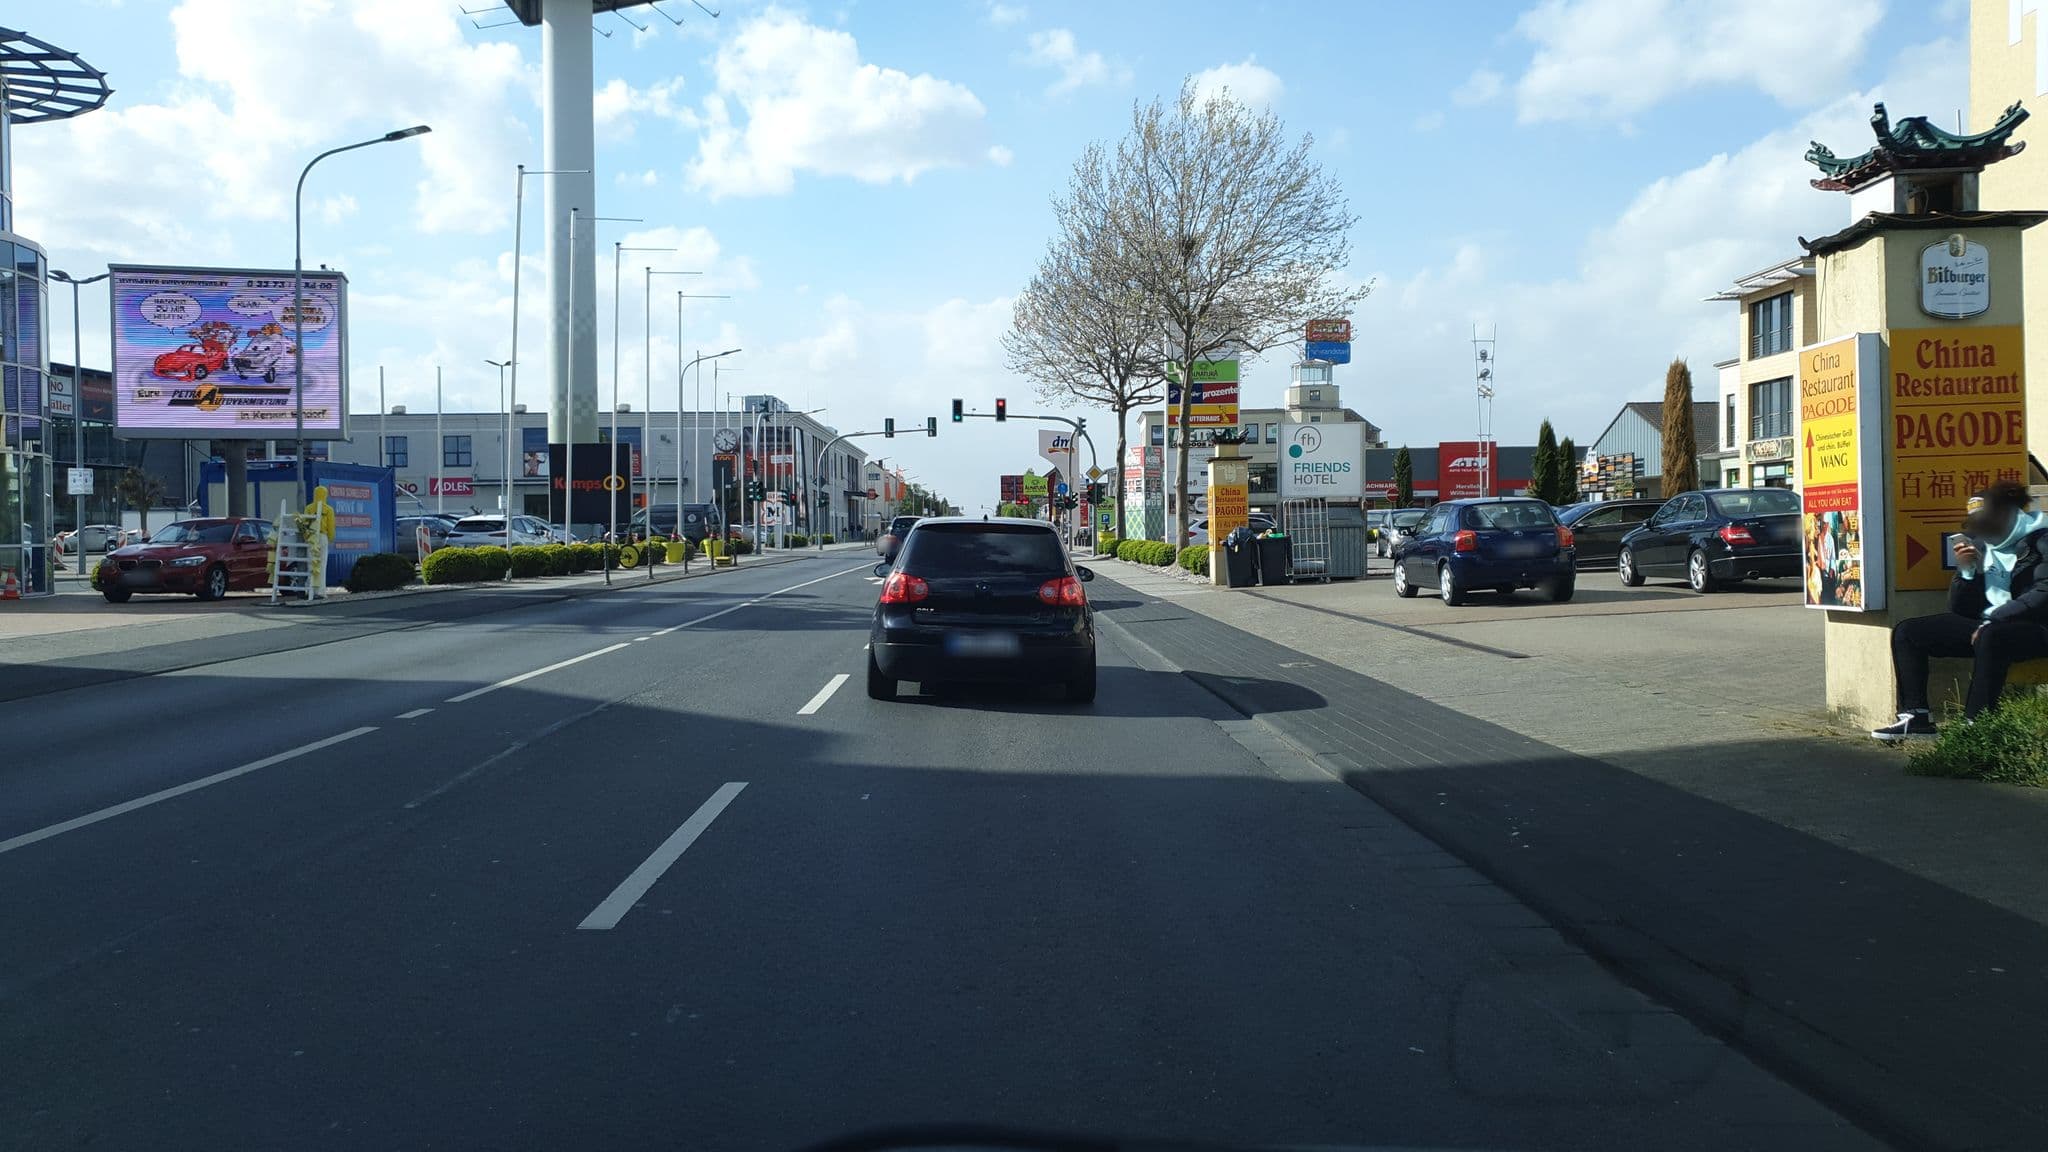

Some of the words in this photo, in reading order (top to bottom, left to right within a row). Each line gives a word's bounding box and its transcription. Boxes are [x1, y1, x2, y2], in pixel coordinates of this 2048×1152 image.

[1928, 266, 1985, 286] Bitburger
[1917, 339, 1995, 369] China
[1813, 352, 1840, 373] China
[1802, 370, 1854, 398] Restaurant
[1896, 371, 2019, 397] Restaurant
[1802, 396, 1856, 419] PAGODE
[1189, 415, 1220, 423] UTTERHAUS
[1896, 410, 2022, 449] PAGODE
[1301, 433, 1315, 446] fh
[1294, 462, 1351, 473] FRIENDS
[1821, 453, 1848, 469] WANG
[433, 481, 470, 492] ADLER
[555, 476, 602, 492] Kmps
[1294, 474, 1338, 485] HOTEL
[1220, 488, 1241, 496] China
[1216, 506, 1247, 515] PAGODE
